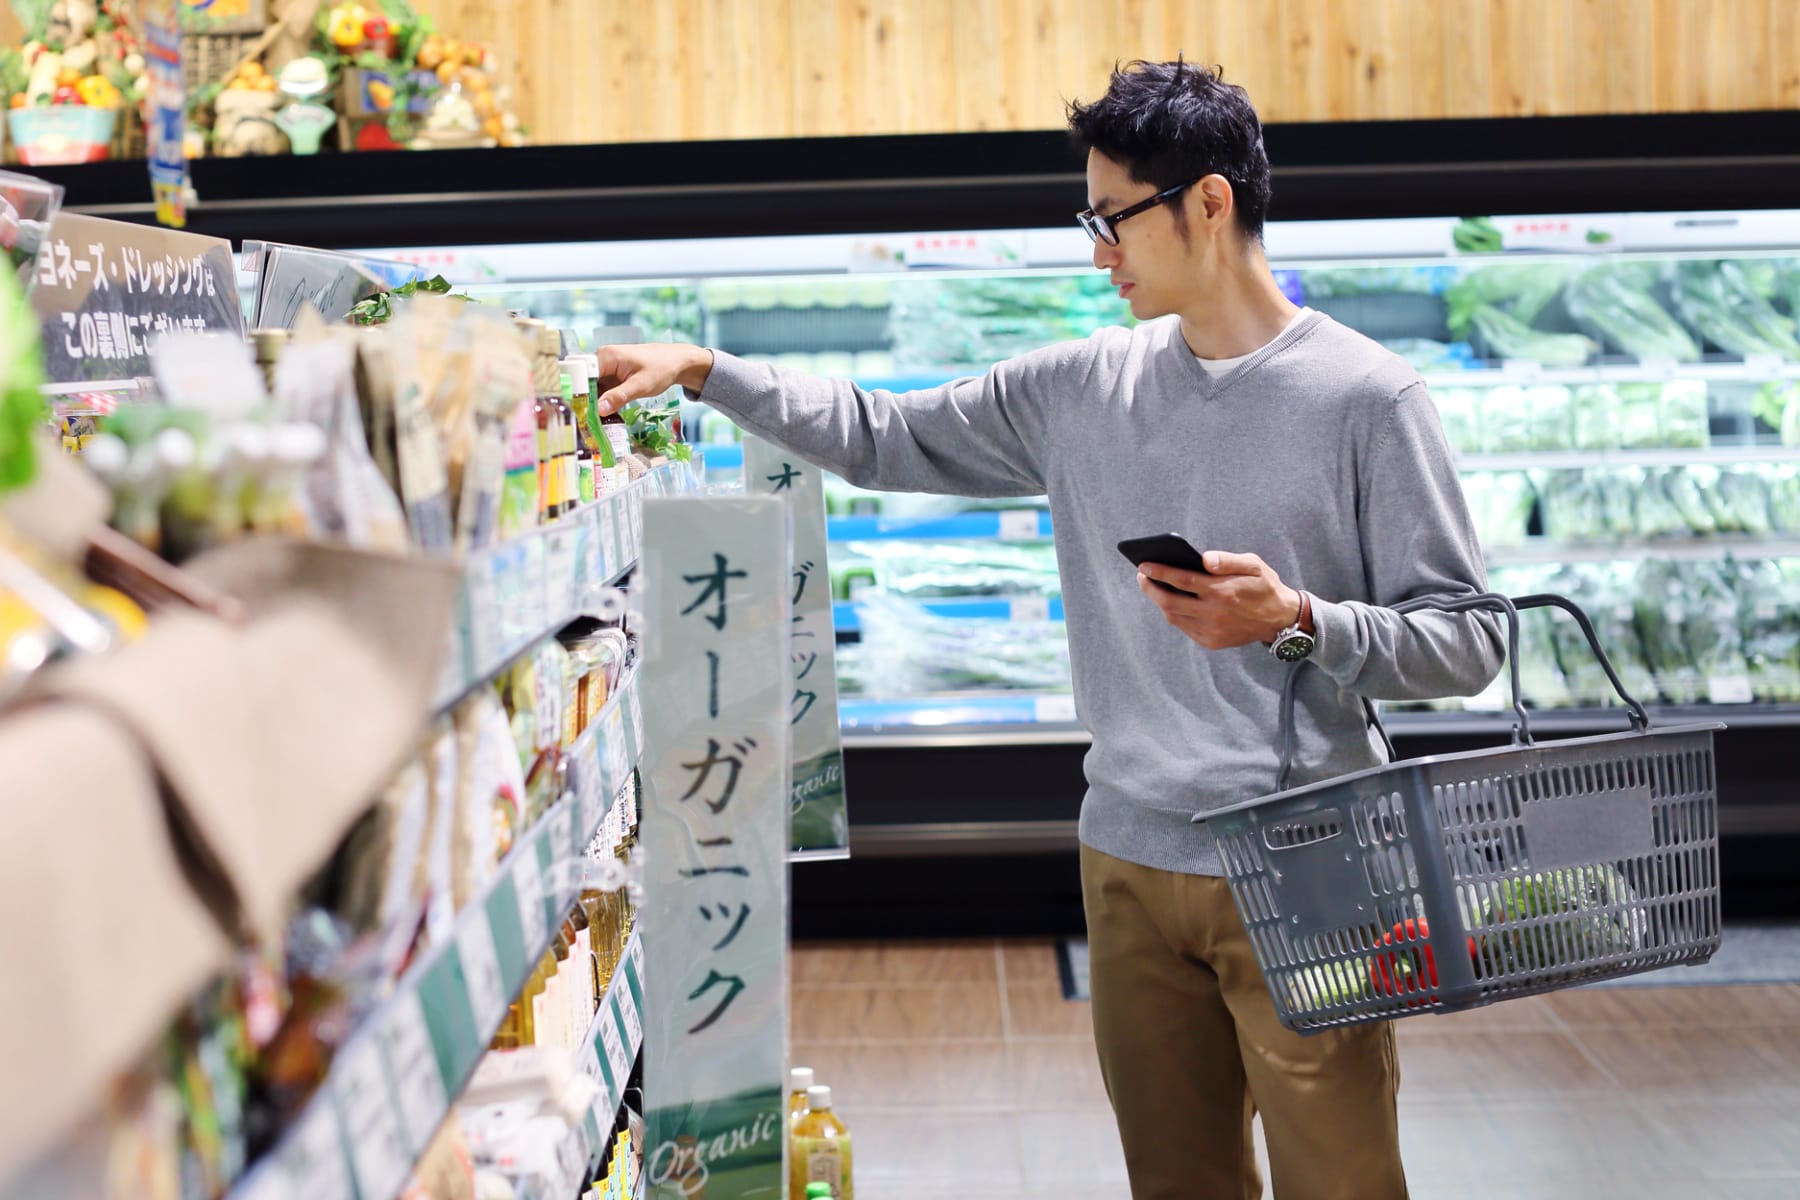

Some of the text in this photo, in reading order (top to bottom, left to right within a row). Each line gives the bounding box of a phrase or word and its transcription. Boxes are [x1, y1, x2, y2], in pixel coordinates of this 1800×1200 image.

[38, 238, 216, 298] ヨネーズ・ドレッシングは
[766, 462, 818, 726] オガニック
[678, 552, 758, 1034] オーガニック
[791, 765, 840, 816] ganic
[647, 1110, 777, 1196] Organic
